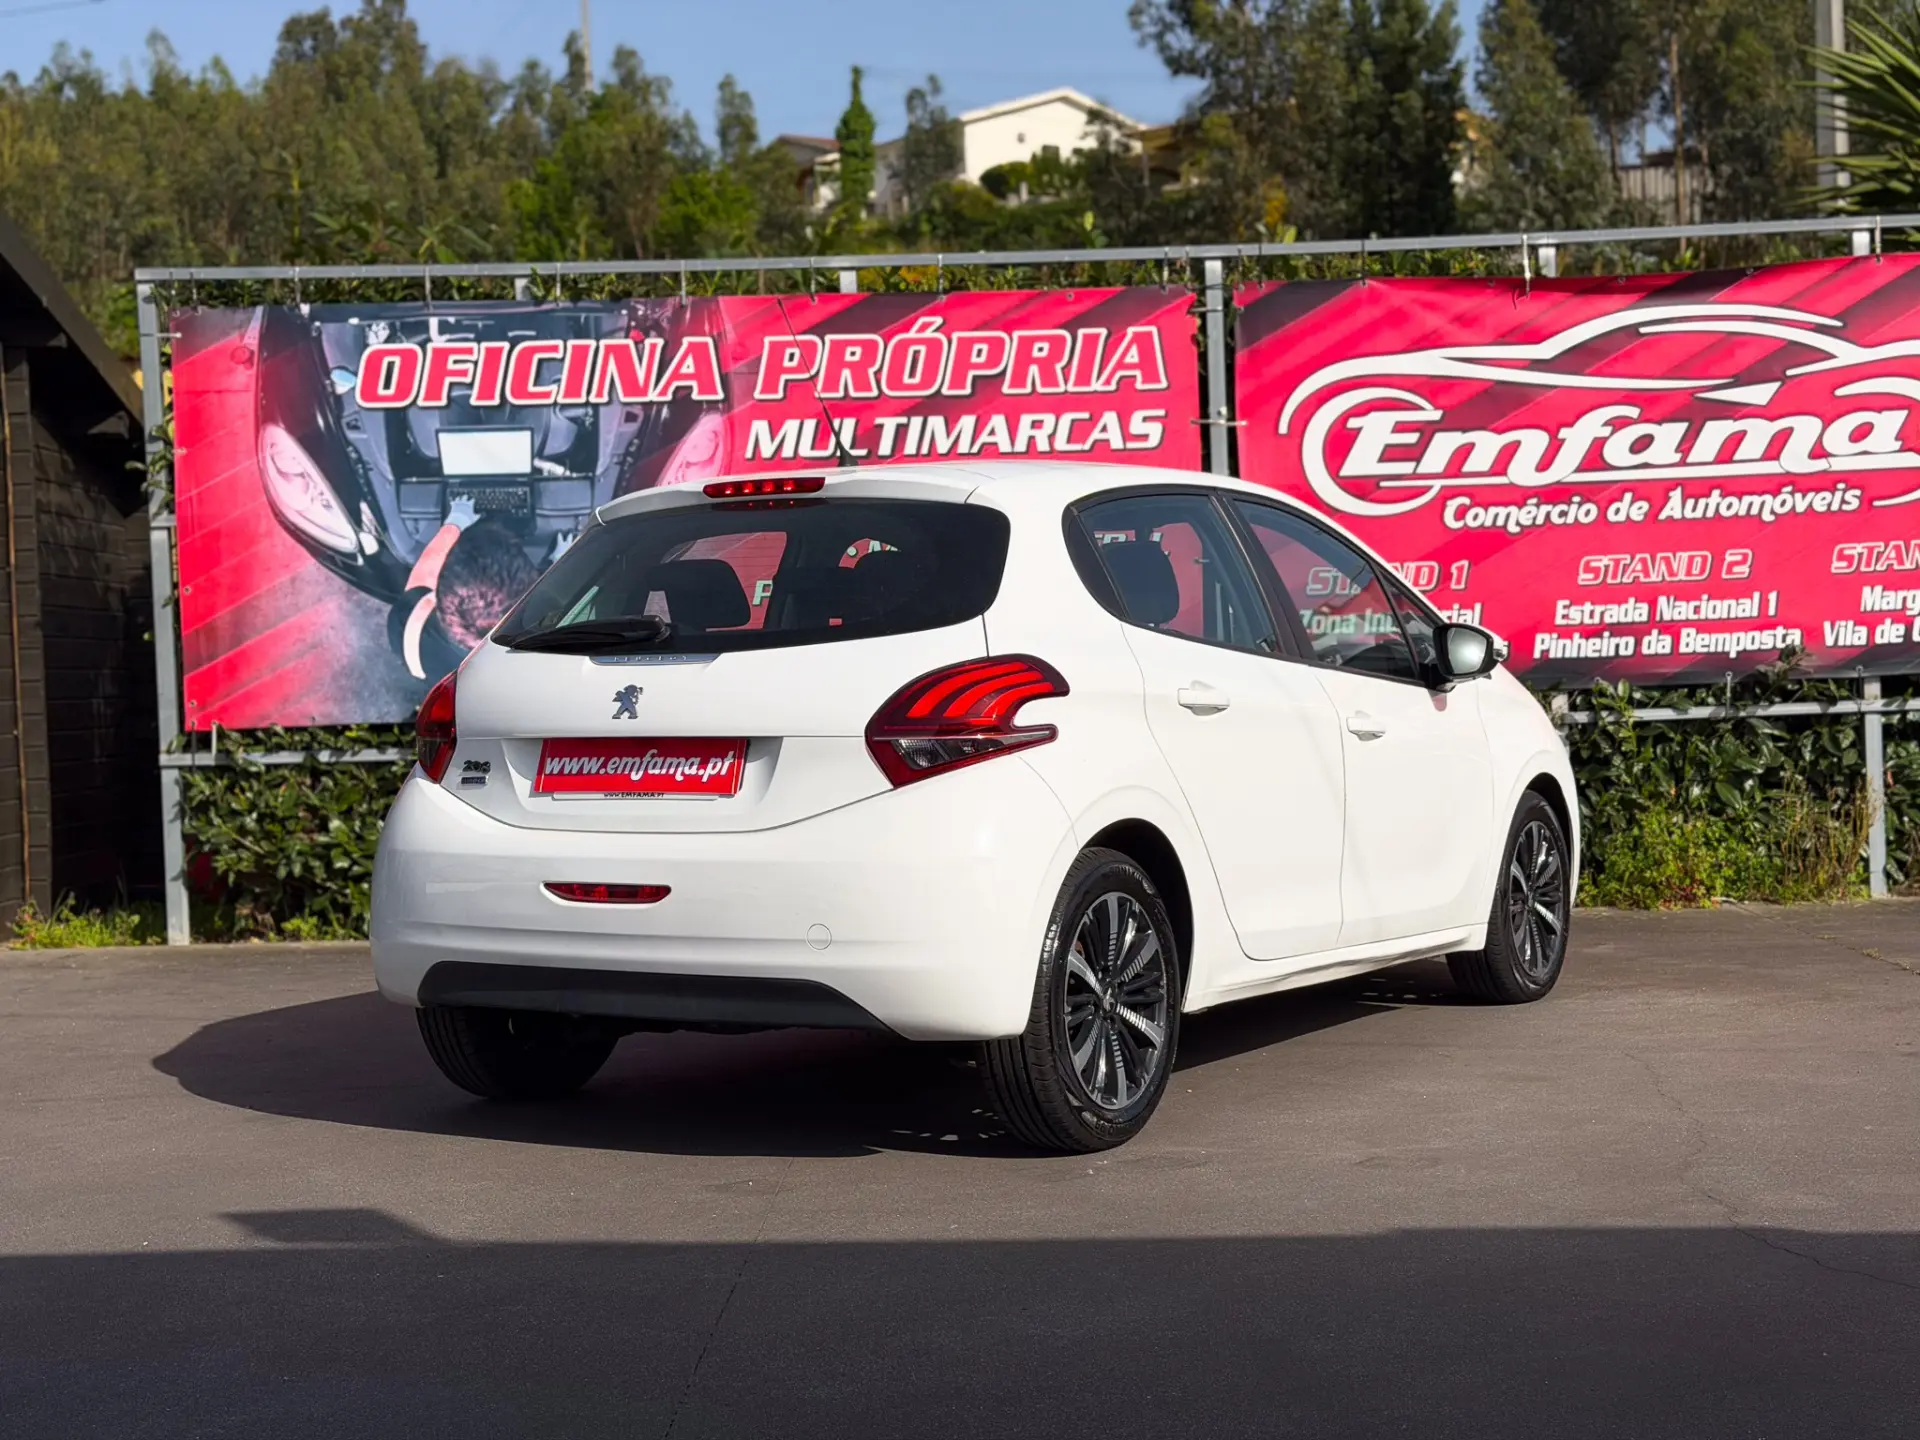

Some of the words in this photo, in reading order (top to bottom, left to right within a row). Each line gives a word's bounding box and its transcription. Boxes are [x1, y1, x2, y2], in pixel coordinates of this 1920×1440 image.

[355, 336, 725, 408] OFICINA
[754, 316, 1169, 399] PRÓPRIA
[744, 408, 1166, 461] MULTIMARCAS
[1337, 404, 1909, 487] Emfama
[1444, 495, 1598, 533] Comércio
[1606, 491, 1646, 523] de
[1658, 482, 1861, 524] Automóveis
[1305, 560, 1441, 597] STND
[1450, 559, 1471, 590] 1
[1577, 551, 1712, 586] STAND
[1721, 549, 1752, 579] 2
[1554, 597, 1649, 626] Estrada
[1655, 590, 1761, 622] Nacional
[1767, 589, 1779, 617] 1
[1533, 631, 1635, 659] Pinheiro
[1641, 628, 1672, 655] da
[1679, 625, 1802, 659] Bemposta
[1823, 619, 1868, 647] Vila
[1874, 617, 1906, 644] de
[544, 748, 735, 783] www.emfama.pt
